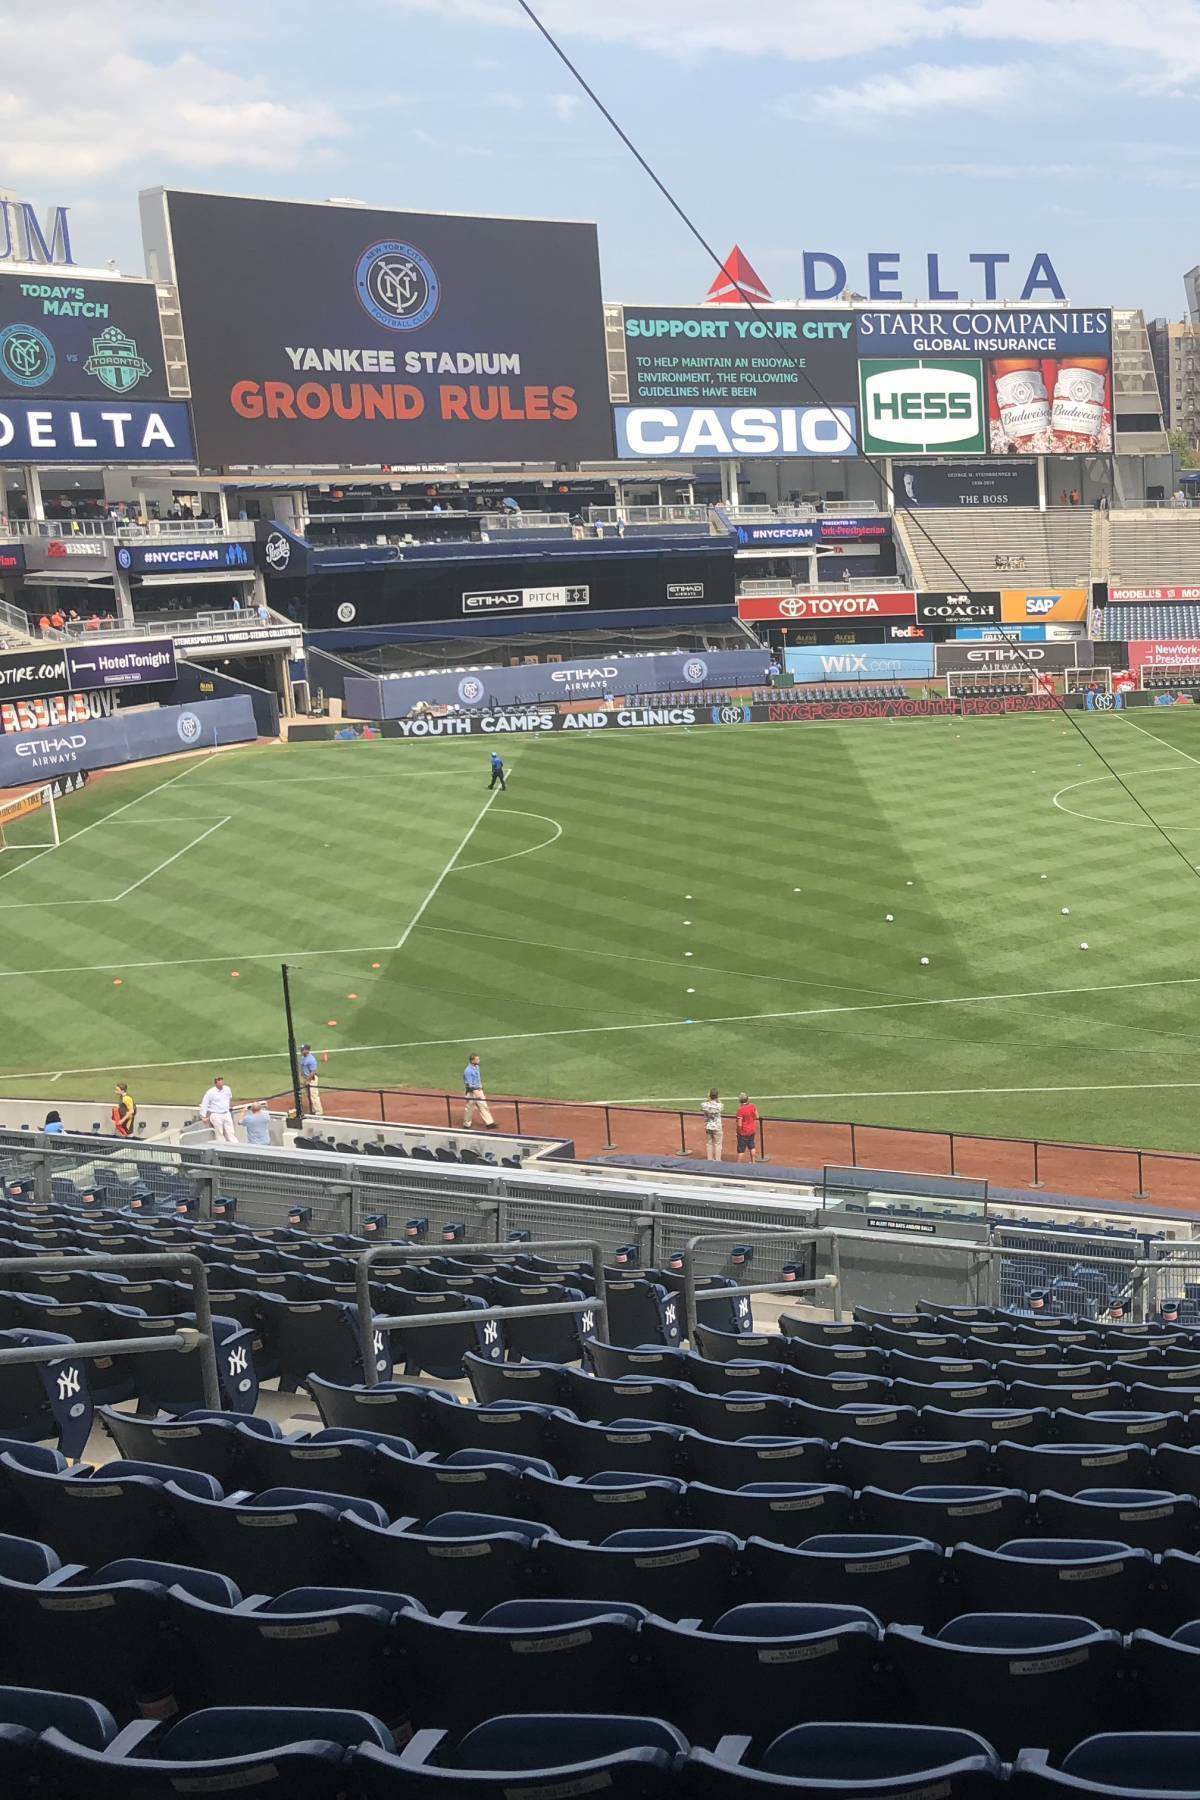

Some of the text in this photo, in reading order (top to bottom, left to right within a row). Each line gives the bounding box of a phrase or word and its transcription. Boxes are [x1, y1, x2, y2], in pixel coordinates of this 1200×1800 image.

[803, 250, 1068, 301] DELTA
[20, 284, 86, 300] TODAY'S
[43, 300, 110, 319] MATCH
[626, 319, 853, 339] SUPPORT YOUR CITY
[860, 312, 1108, 336] STARR COMPANIES
[913, 338, 1057, 351] GLOBAL INSURANCE
[285, 347, 521, 375] YANKEE STADIUM
[636, 356, 651, 368] TO
[653, 357, 679, 368] HELP
[681, 357, 732, 368] MAINTAIN
[734, 357, 749, 368] AN
[637, 372, 799, 385] ENVIRONMENT, THE FOLLOWING
[230, 379, 579, 420] GROUND RULES
[638, 386, 758, 398] GUIDELINES HAVE BEEN
[873, 391, 973, 420] HESS
[626, 407, 853, 455] CASIO
[959, 494, 1009, 504] THE BOSS
[752, 528, 814, 539] #NYCFCFAM
[144, 549, 219, 563] #NYCFCFAM
[668, 585, 702, 593] ETIHAD
[1113, 589, 1162, 600] MODELL'S
[466, 592, 560, 607] ETIHAD PITCH
[808, 597, 880, 614] TOYOTA
[1026, 599, 1055, 613] SAP
[923, 605, 995, 617] COACH
[891, 626, 925, 639] FedEx
[967, 648, 1046, 661] ETIHAD
[551, 666, 619, 682] ETIHAD
[564, 680, 608, 691] AIRWAYS
[398, 709, 696, 736] YOUTH CAMPS AND CLINICS
[15, 734, 87, 757] ETIHAD
[32, 752, 77, 768] AIRWAYS
